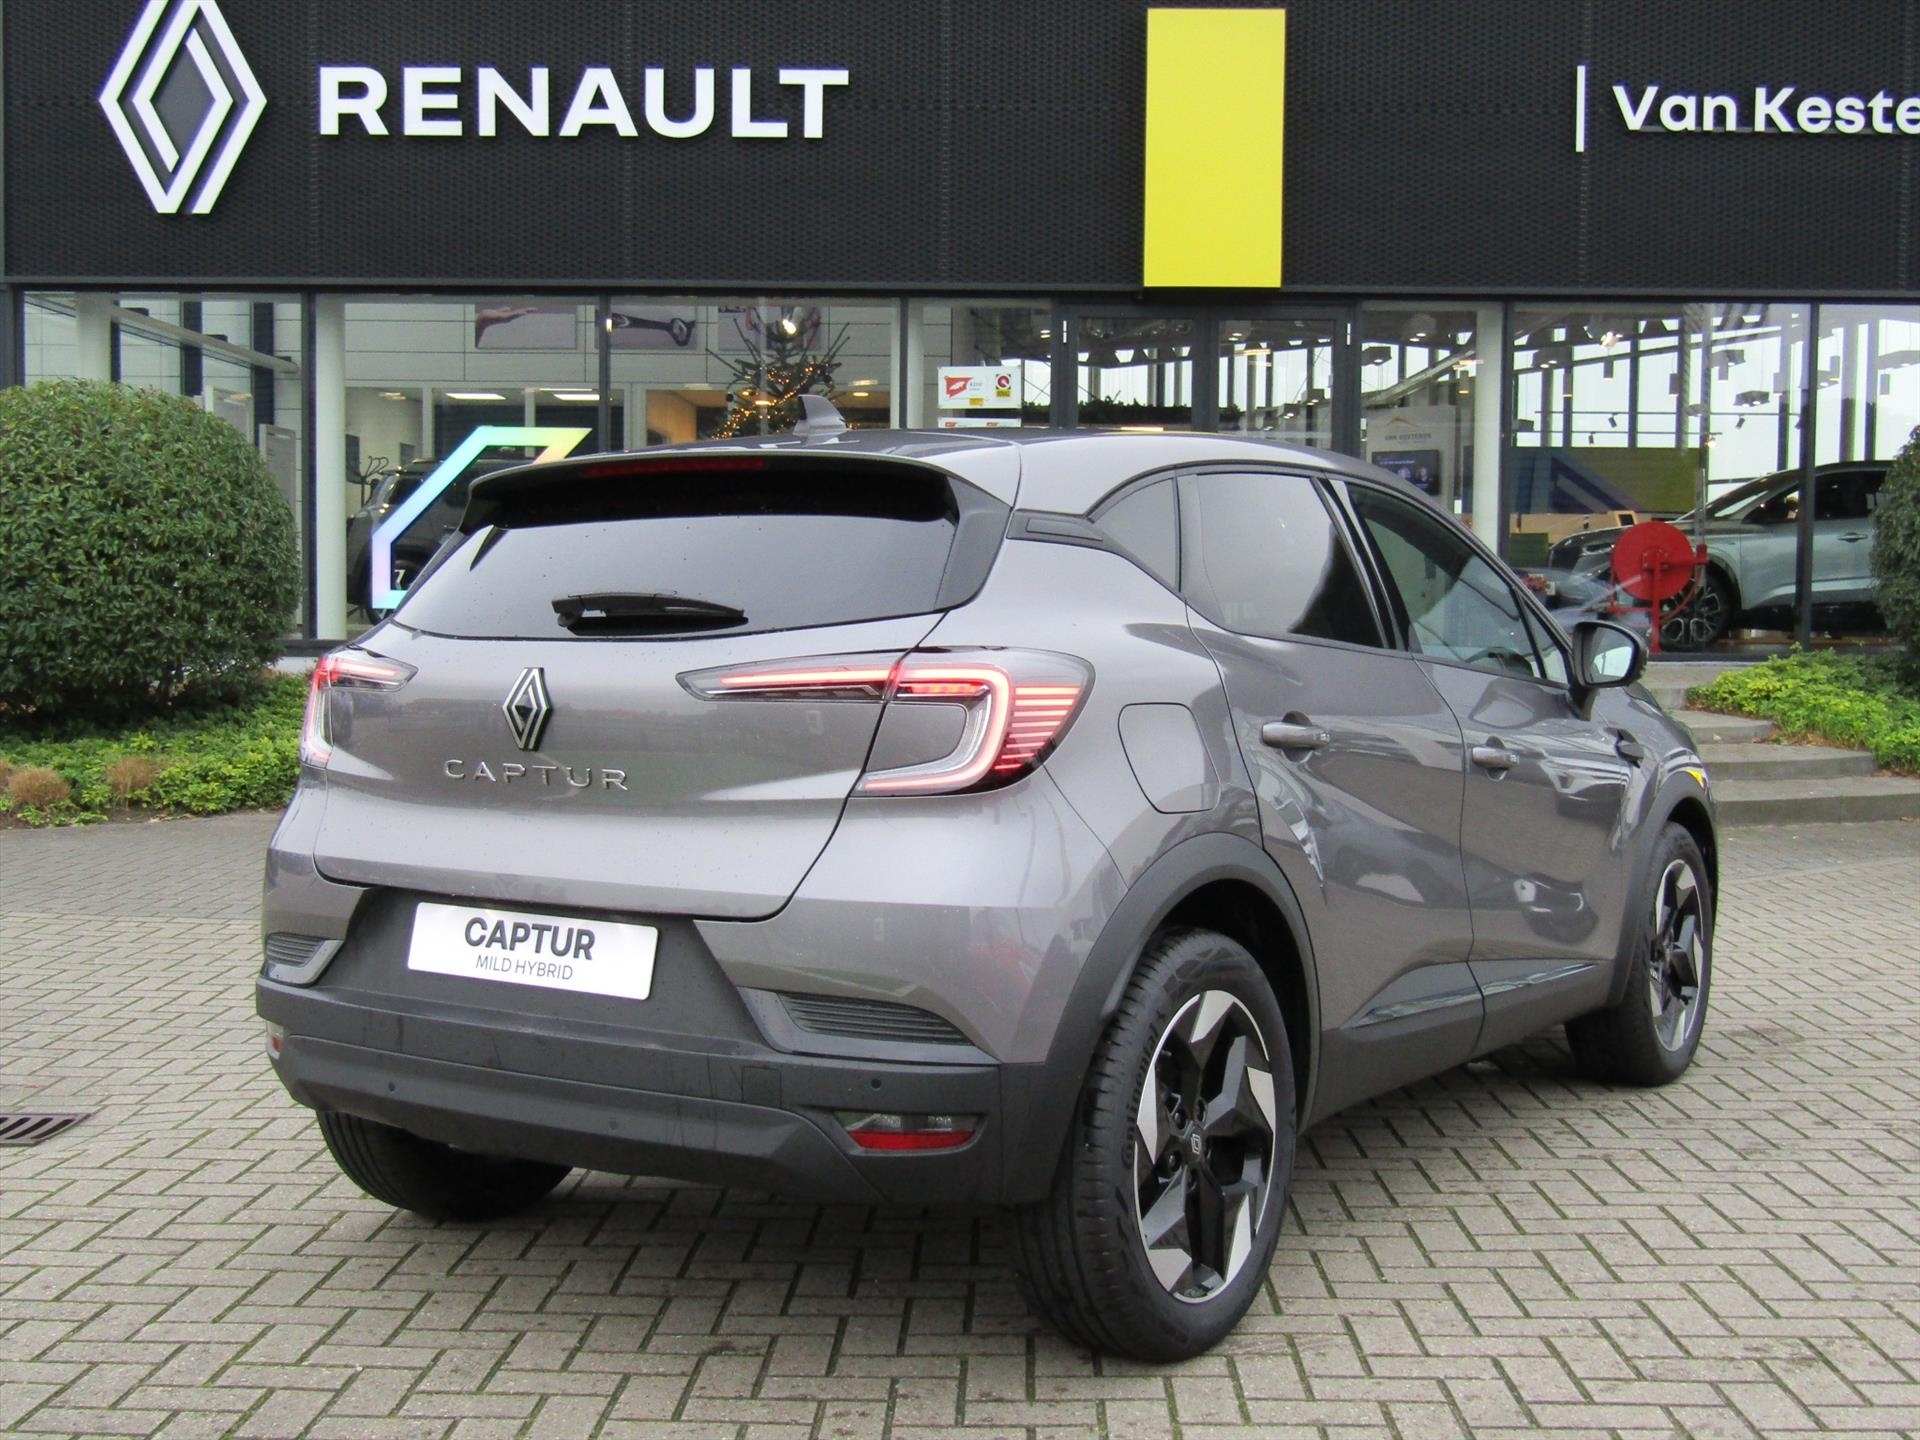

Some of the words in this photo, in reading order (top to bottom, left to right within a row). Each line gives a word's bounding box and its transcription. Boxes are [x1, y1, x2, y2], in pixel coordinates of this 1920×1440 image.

[319, 66, 849, 138] RENAULT
[1612, 86, 1737, 132] Van
[1755, 88, 1920, 134] Keste
[444, 759, 629, 791] CAPTUR
[465, 917, 595, 960] CAPTUR
[476, 955, 512, 973] MILD
[515, 960, 574, 981] HYBRID
